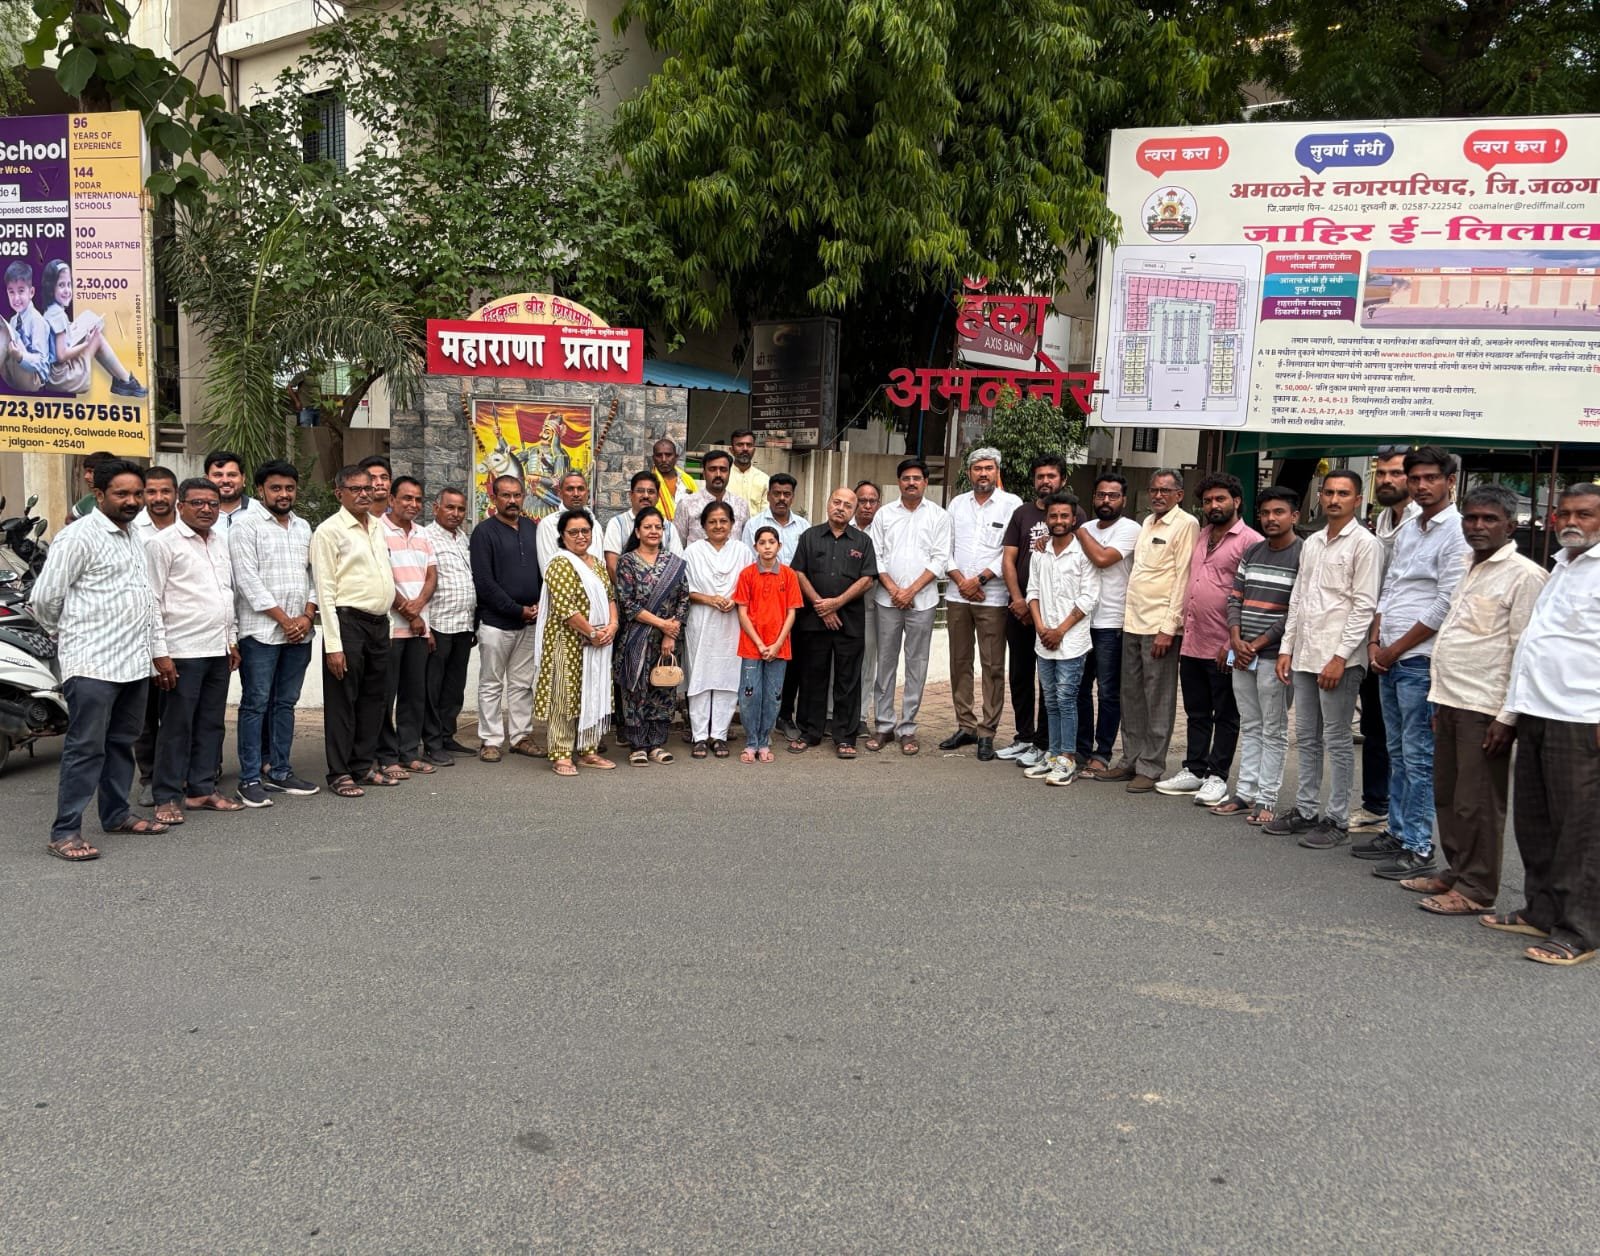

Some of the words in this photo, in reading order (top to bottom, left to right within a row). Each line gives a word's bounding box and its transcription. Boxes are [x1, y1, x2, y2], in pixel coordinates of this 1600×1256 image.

[73, 117, 88, 129] 96
[73, 132, 99, 140] YEARS
[101, 131, 112, 139] OF
[73, 141, 122, 150] EXPERIENCE
[1310, 139, 1349, 162] सुवर्ण
[1353, 139, 1385, 157] संधी
[1472, 140, 1509, 155] त्वरा
[1515, 139, 1547, 154] करा
[1554, 139, 1561, 153] !
[1144, 148, 1176, 163] त्वरा
[1182, 146, 1210, 161] करा
[1217, 146, 1223, 160] !
[5, 166, 18, 174] We
[19, 166, 33, 174] Go.
[74, 167, 94, 178] 144
[11, 187, 17, 197] 4
[1229, 175, 1326, 199] अमळनेर
[1333, 172, 1475, 197] नगरपरिषद,
[25, 206, 43, 214] CBSE
[44, 205, 68, 213] School
[75, 202, 112, 210] SCHOOLS
[1328, 203, 1358, 212] 425401
[1402, 202, 1462, 211] 02587-222542
[1468, 201, 1585, 211] coamalner@rediffmail.com
[36, 224, 65, 238] FOR
[75, 227, 96, 238] 100
[1243, 217, 1376, 245] जाहिर
[0, 241, 28, 256] 026
[1276, 253, 1305, 262] शहरातील
[76, 278, 128, 291] 2,30,000
[76, 292, 117, 300] STUDENTS
[525, 296, 545, 314] वीर
[438, 330, 546, 368] महाराणा
[560, 336, 631, 372] प्रताप
[984, 335, 1002, 350] AXIS
[1004, 339, 1024, 355] BANK
[1381, 351, 1455, 359] www.eauction.gov.in
[885, 351, 1100, 415] अमळनेर
[1284, 384, 1313, 392] 50,000/-
[0, 400, 141, 423] 723,9175675651
[22, 425, 73, 437] Residency,
[74, 427, 117, 437] Galwade
[118, 429, 146, 441] Road,
[8, 436, 44, 448] jalgaon
[52, 439, 85, 449] 425401
